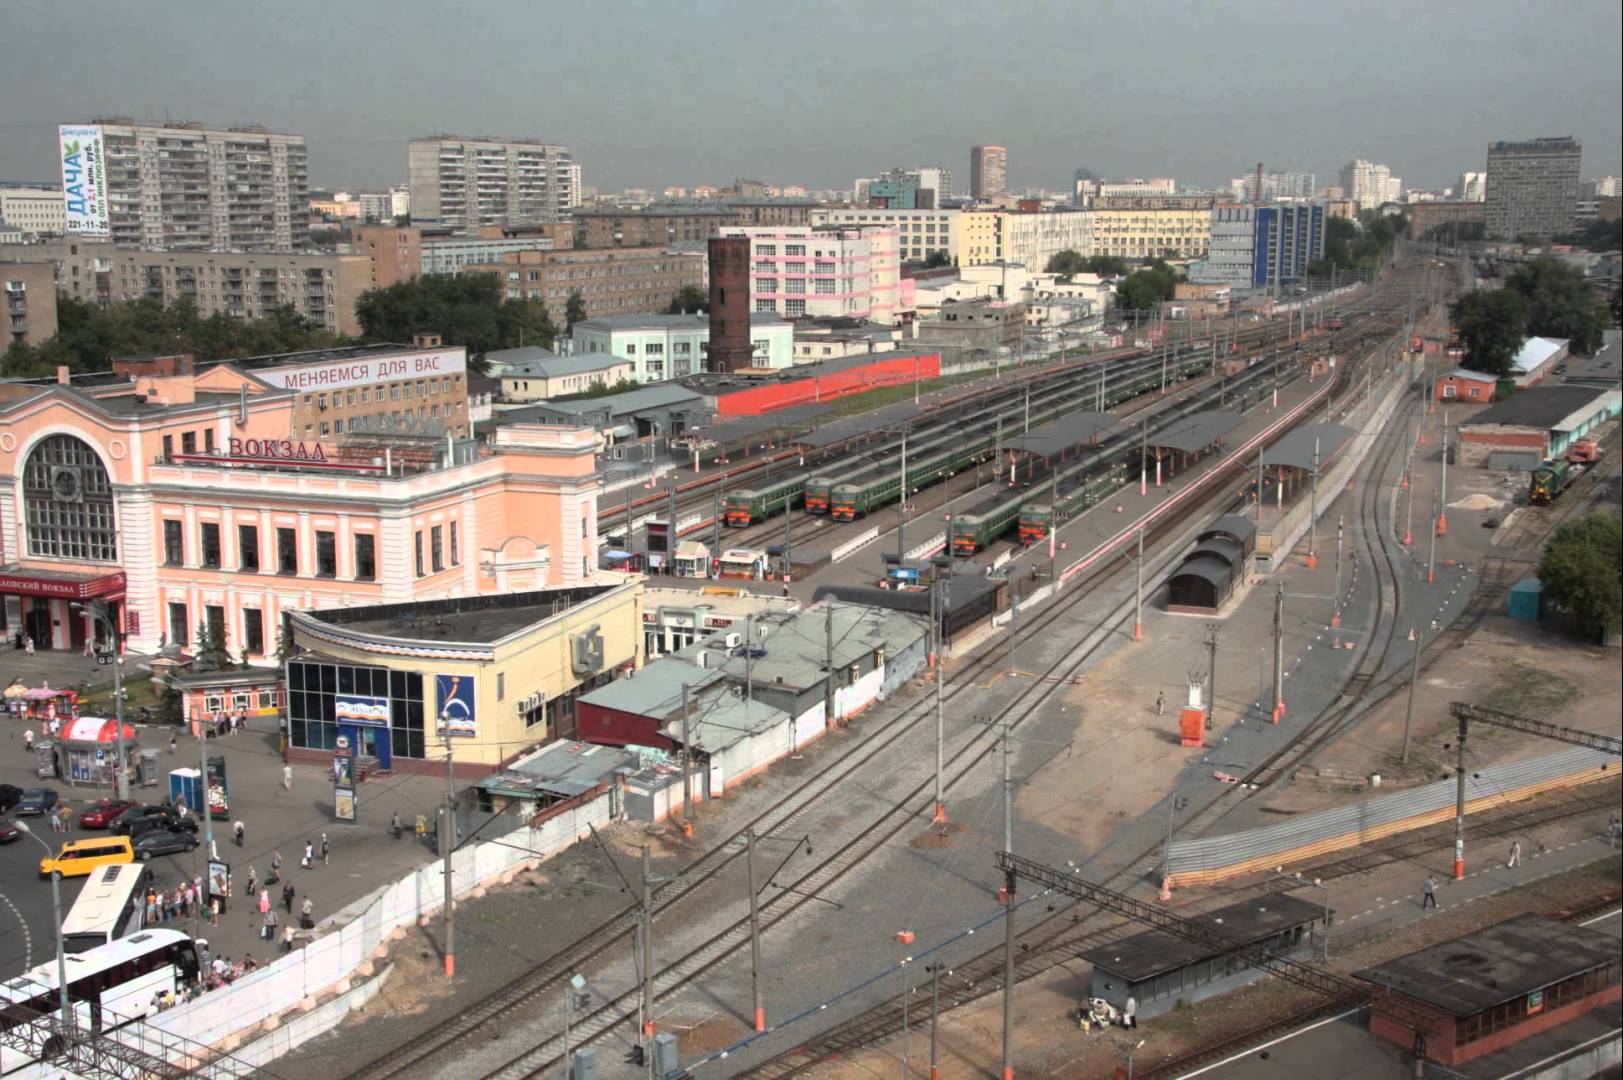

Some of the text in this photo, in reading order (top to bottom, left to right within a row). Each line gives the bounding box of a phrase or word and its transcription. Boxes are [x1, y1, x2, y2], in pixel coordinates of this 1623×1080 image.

[85, 143, 94, 162] руб.
[64, 154, 88, 216] ДАЧА
[87, 188, 96, 202] 2,1
[90, 204, 96, 214] от
[68, 220, 109, 229] 221-11-20
[285, 357, 440, 389] МЕНЯЕМСЯ ДЛЯ ВАС
[228, 438, 326, 460] ВОКЗАЛ
[0, 580, 74, 593] ЛОВСКИЙ ВОКЗАЛ
